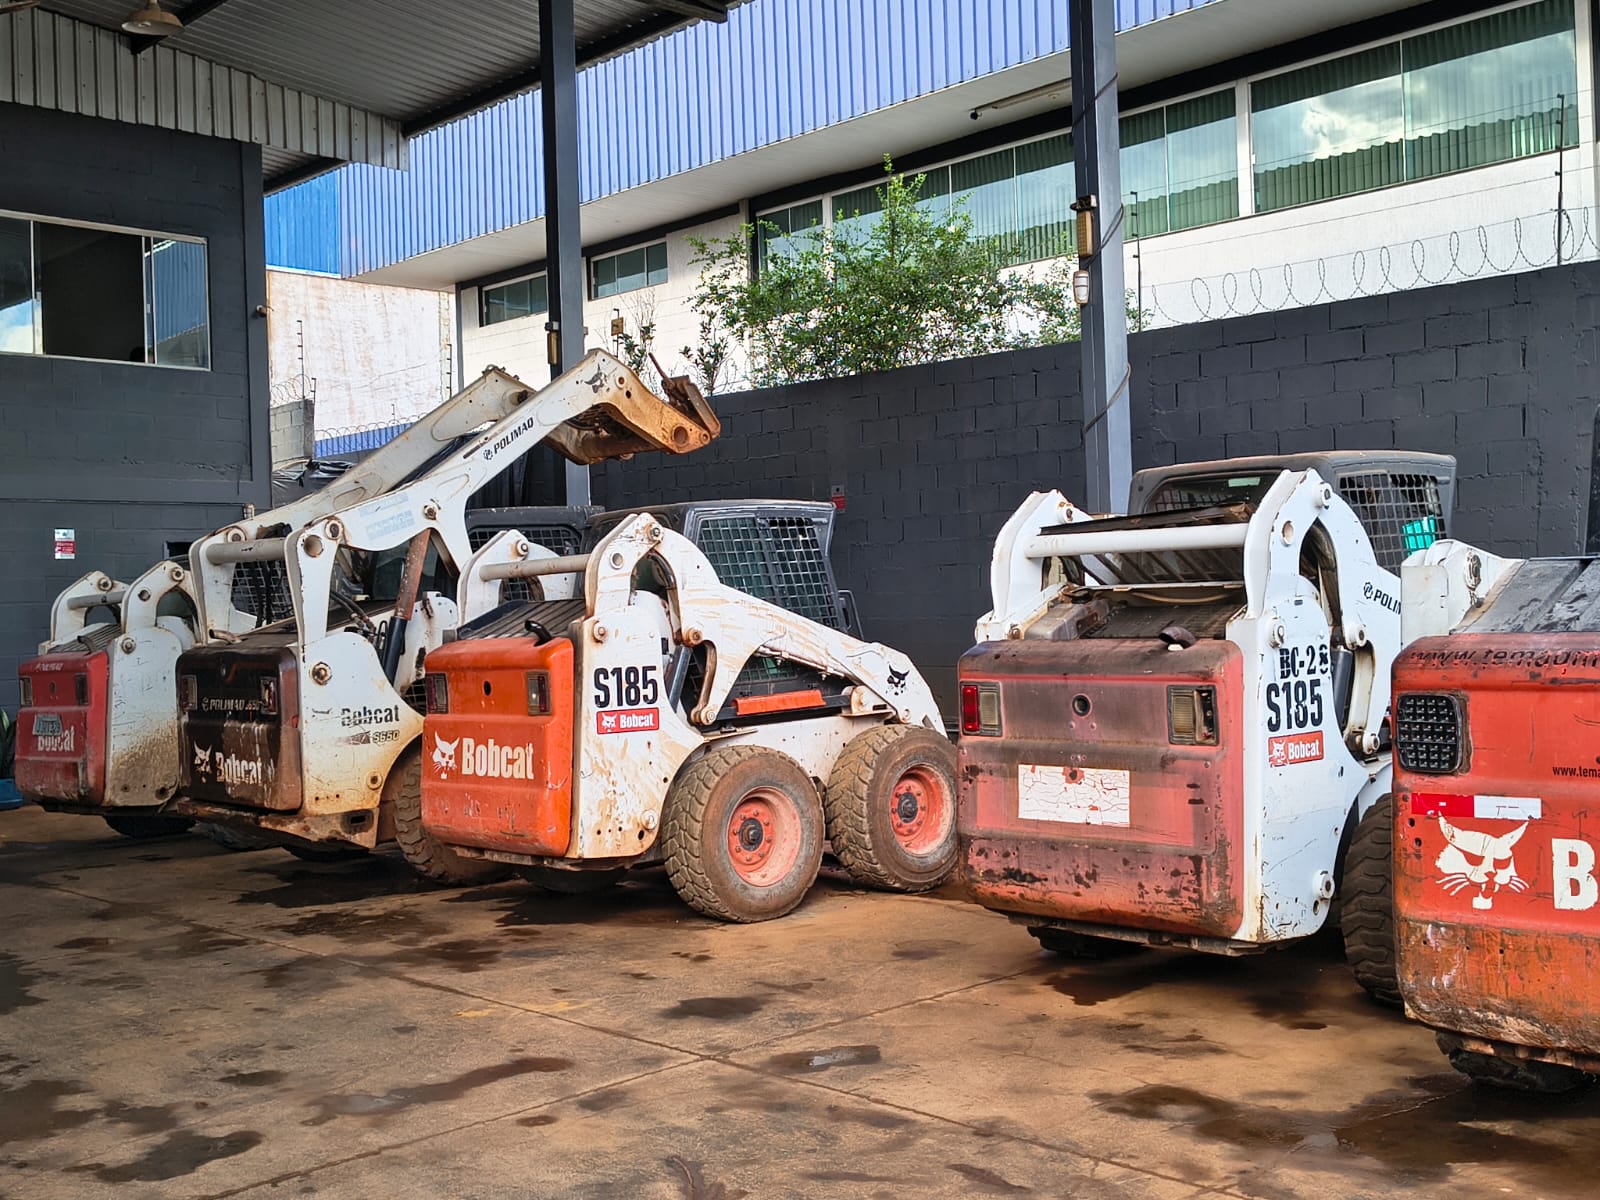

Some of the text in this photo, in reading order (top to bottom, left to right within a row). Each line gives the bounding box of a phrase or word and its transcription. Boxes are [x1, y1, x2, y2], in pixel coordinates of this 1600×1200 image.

[593, 665, 659, 709] S185
[340, 704, 400, 727] Bobcat
[619, 712, 655, 729] Bobcat
[1266, 678, 1323, 733] S185
[461, 737, 535, 780] Bobcat
[1287, 739, 1320, 761] Bobcat
[214, 751, 263, 786] Bobcat
